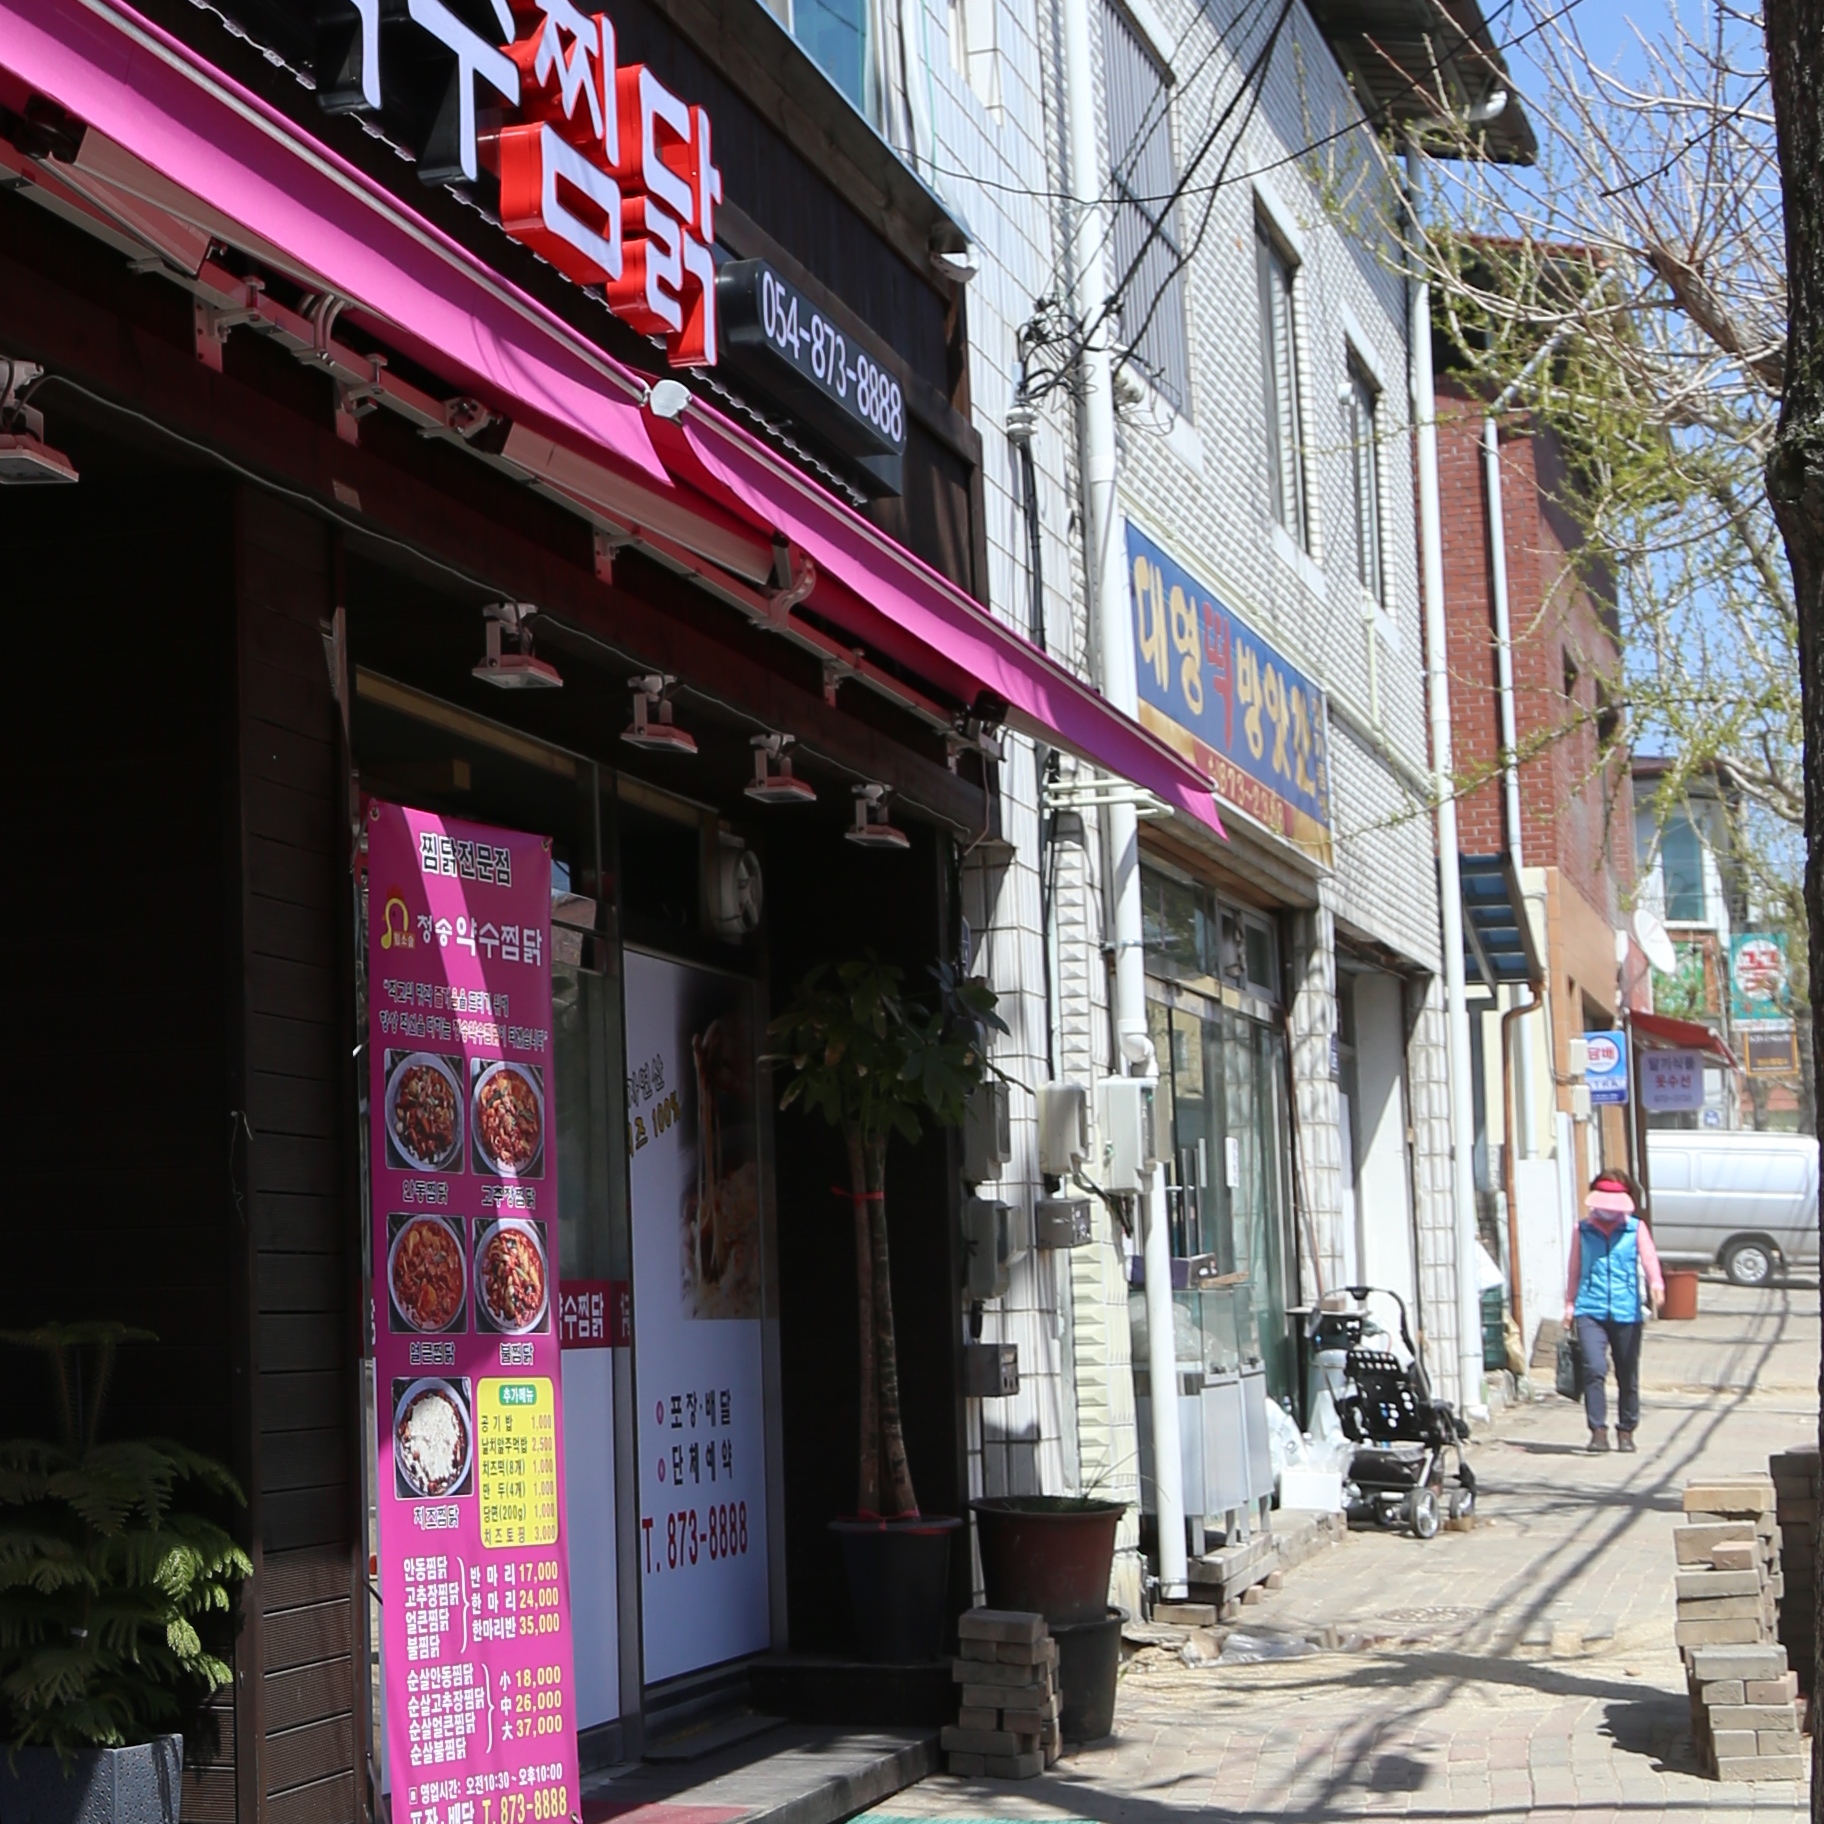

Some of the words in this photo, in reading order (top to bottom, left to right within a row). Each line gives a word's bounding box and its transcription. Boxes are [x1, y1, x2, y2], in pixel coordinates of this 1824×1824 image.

[762, 270, 902, 443] 054-873-8888
[419, 832, 512, 887] 찜닭전문점
[417, 914, 542, 966] 청송약수찜닭
[652, 1090, 682, 1137] 100%
[403, 1179, 449, 1205] 안동찜닭
[481, 1185, 536, 1210] 고추장찜닭
[409, 1341, 455, 1365] 얼큰찜닭
[499, 1342, 534, 1366] 불찜닭
[503, 1387, 535, 1404] 추가메뉴
[531, 1415, 552, 1431] 1,000
[532, 1436, 553, 1453] 2,500
[533, 1458, 553, 1474] 1,000
[533, 1480, 554, 1497] 1,000
[414, 1504, 459, 1531] 치즈찜닭
[483, 1502, 527, 1523] 당면(200g)
[534, 1503, 555, 1519] 1,000
[534, 1525, 556, 1541] 3,000
[667, 1500, 748, 1570] 873-8888
[403, 1555, 447, 1582] 안동찜닭
[519, 1561, 558, 1584] 17,000
[405, 1581, 459, 1608] 고추장찜닭
[519, 1587, 559, 1610] 24,000
[405, 1608, 449, 1635] 얼큰찜닭
[472, 1616, 517, 1642] 한마리반
[519, 1613, 560, 1636] 35,000
[407, 1634, 440, 1661] 불찜닭
[407, 1662, 473, 1692] 순살안동찜닭
[499, 1670, 511, 1692] 小
[515, 1665, 561, 1689] 18,000
[407, 1687, 485, 1718] 순살고추장찜닭
[500, 1696, 512, 1717] 中
[515, 1690, 562, 1713] 26,000
[408, 1712, 476, 1742] 순살얼큰찜닭
[501, 1721, 514, 1741] 大
[516, 1714, 563, 1738] 37,000
[410, 1737, 467, 1767] 순살불찜닭
[420, 1778, 462, 1805] 영업시간:
